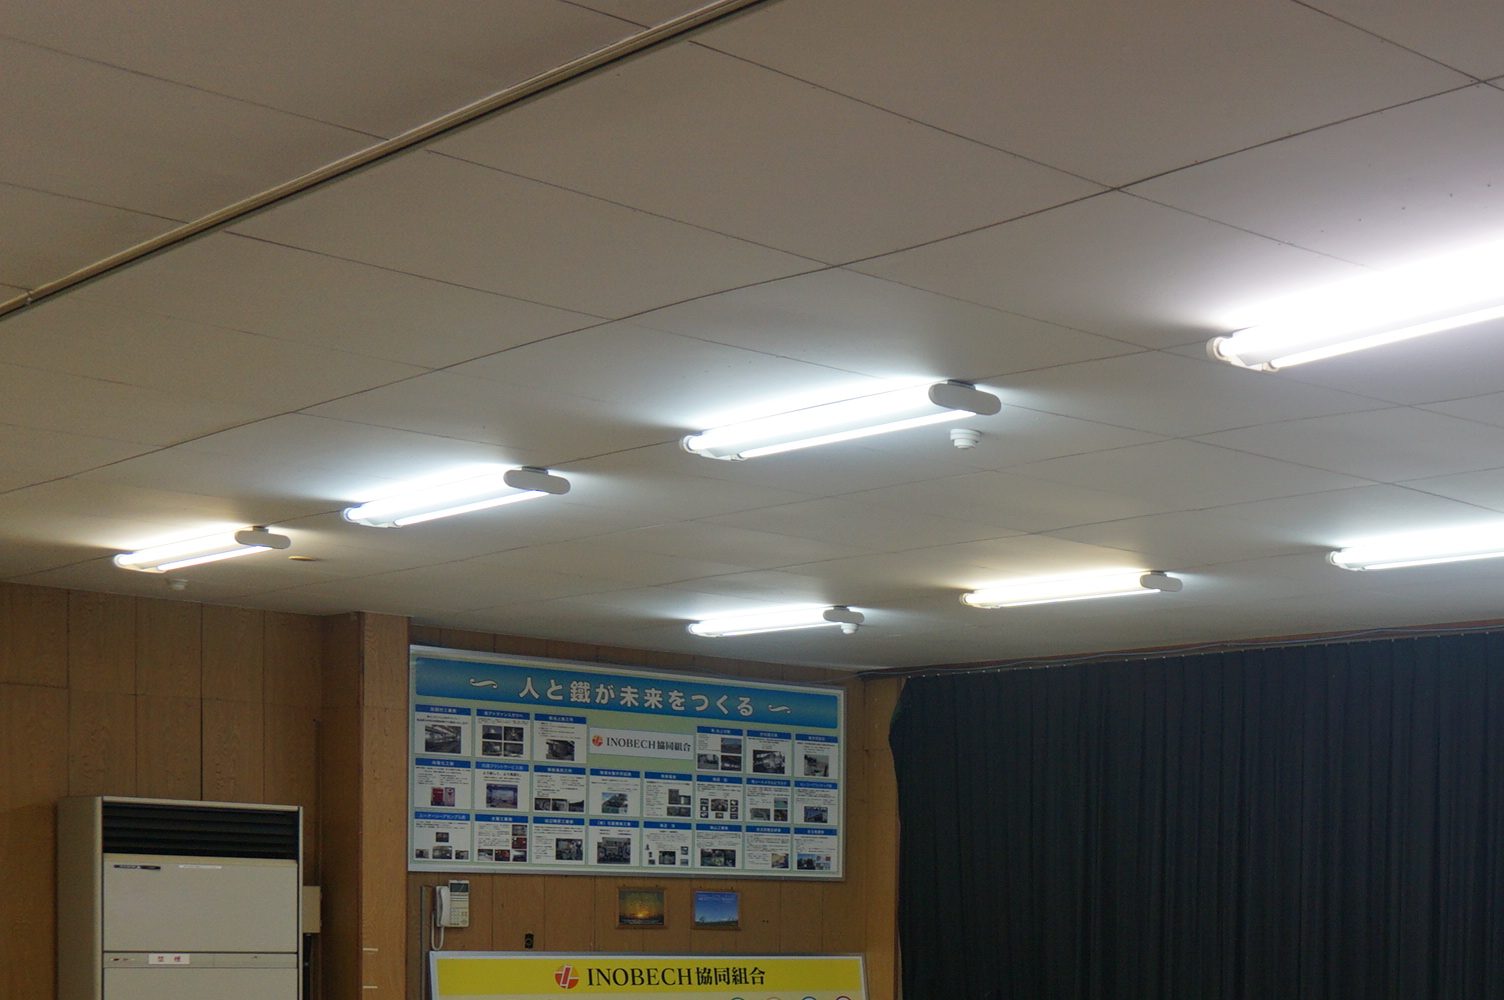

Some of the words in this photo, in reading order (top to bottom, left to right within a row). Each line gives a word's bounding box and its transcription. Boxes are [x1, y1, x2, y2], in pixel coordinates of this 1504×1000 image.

[517, 676, 755, 717] 人と鐵が未来をつくる
[606, 736, 692, 752] INOBECH協同組合
[586, 966, 766, 986] INOBECH協同組合
